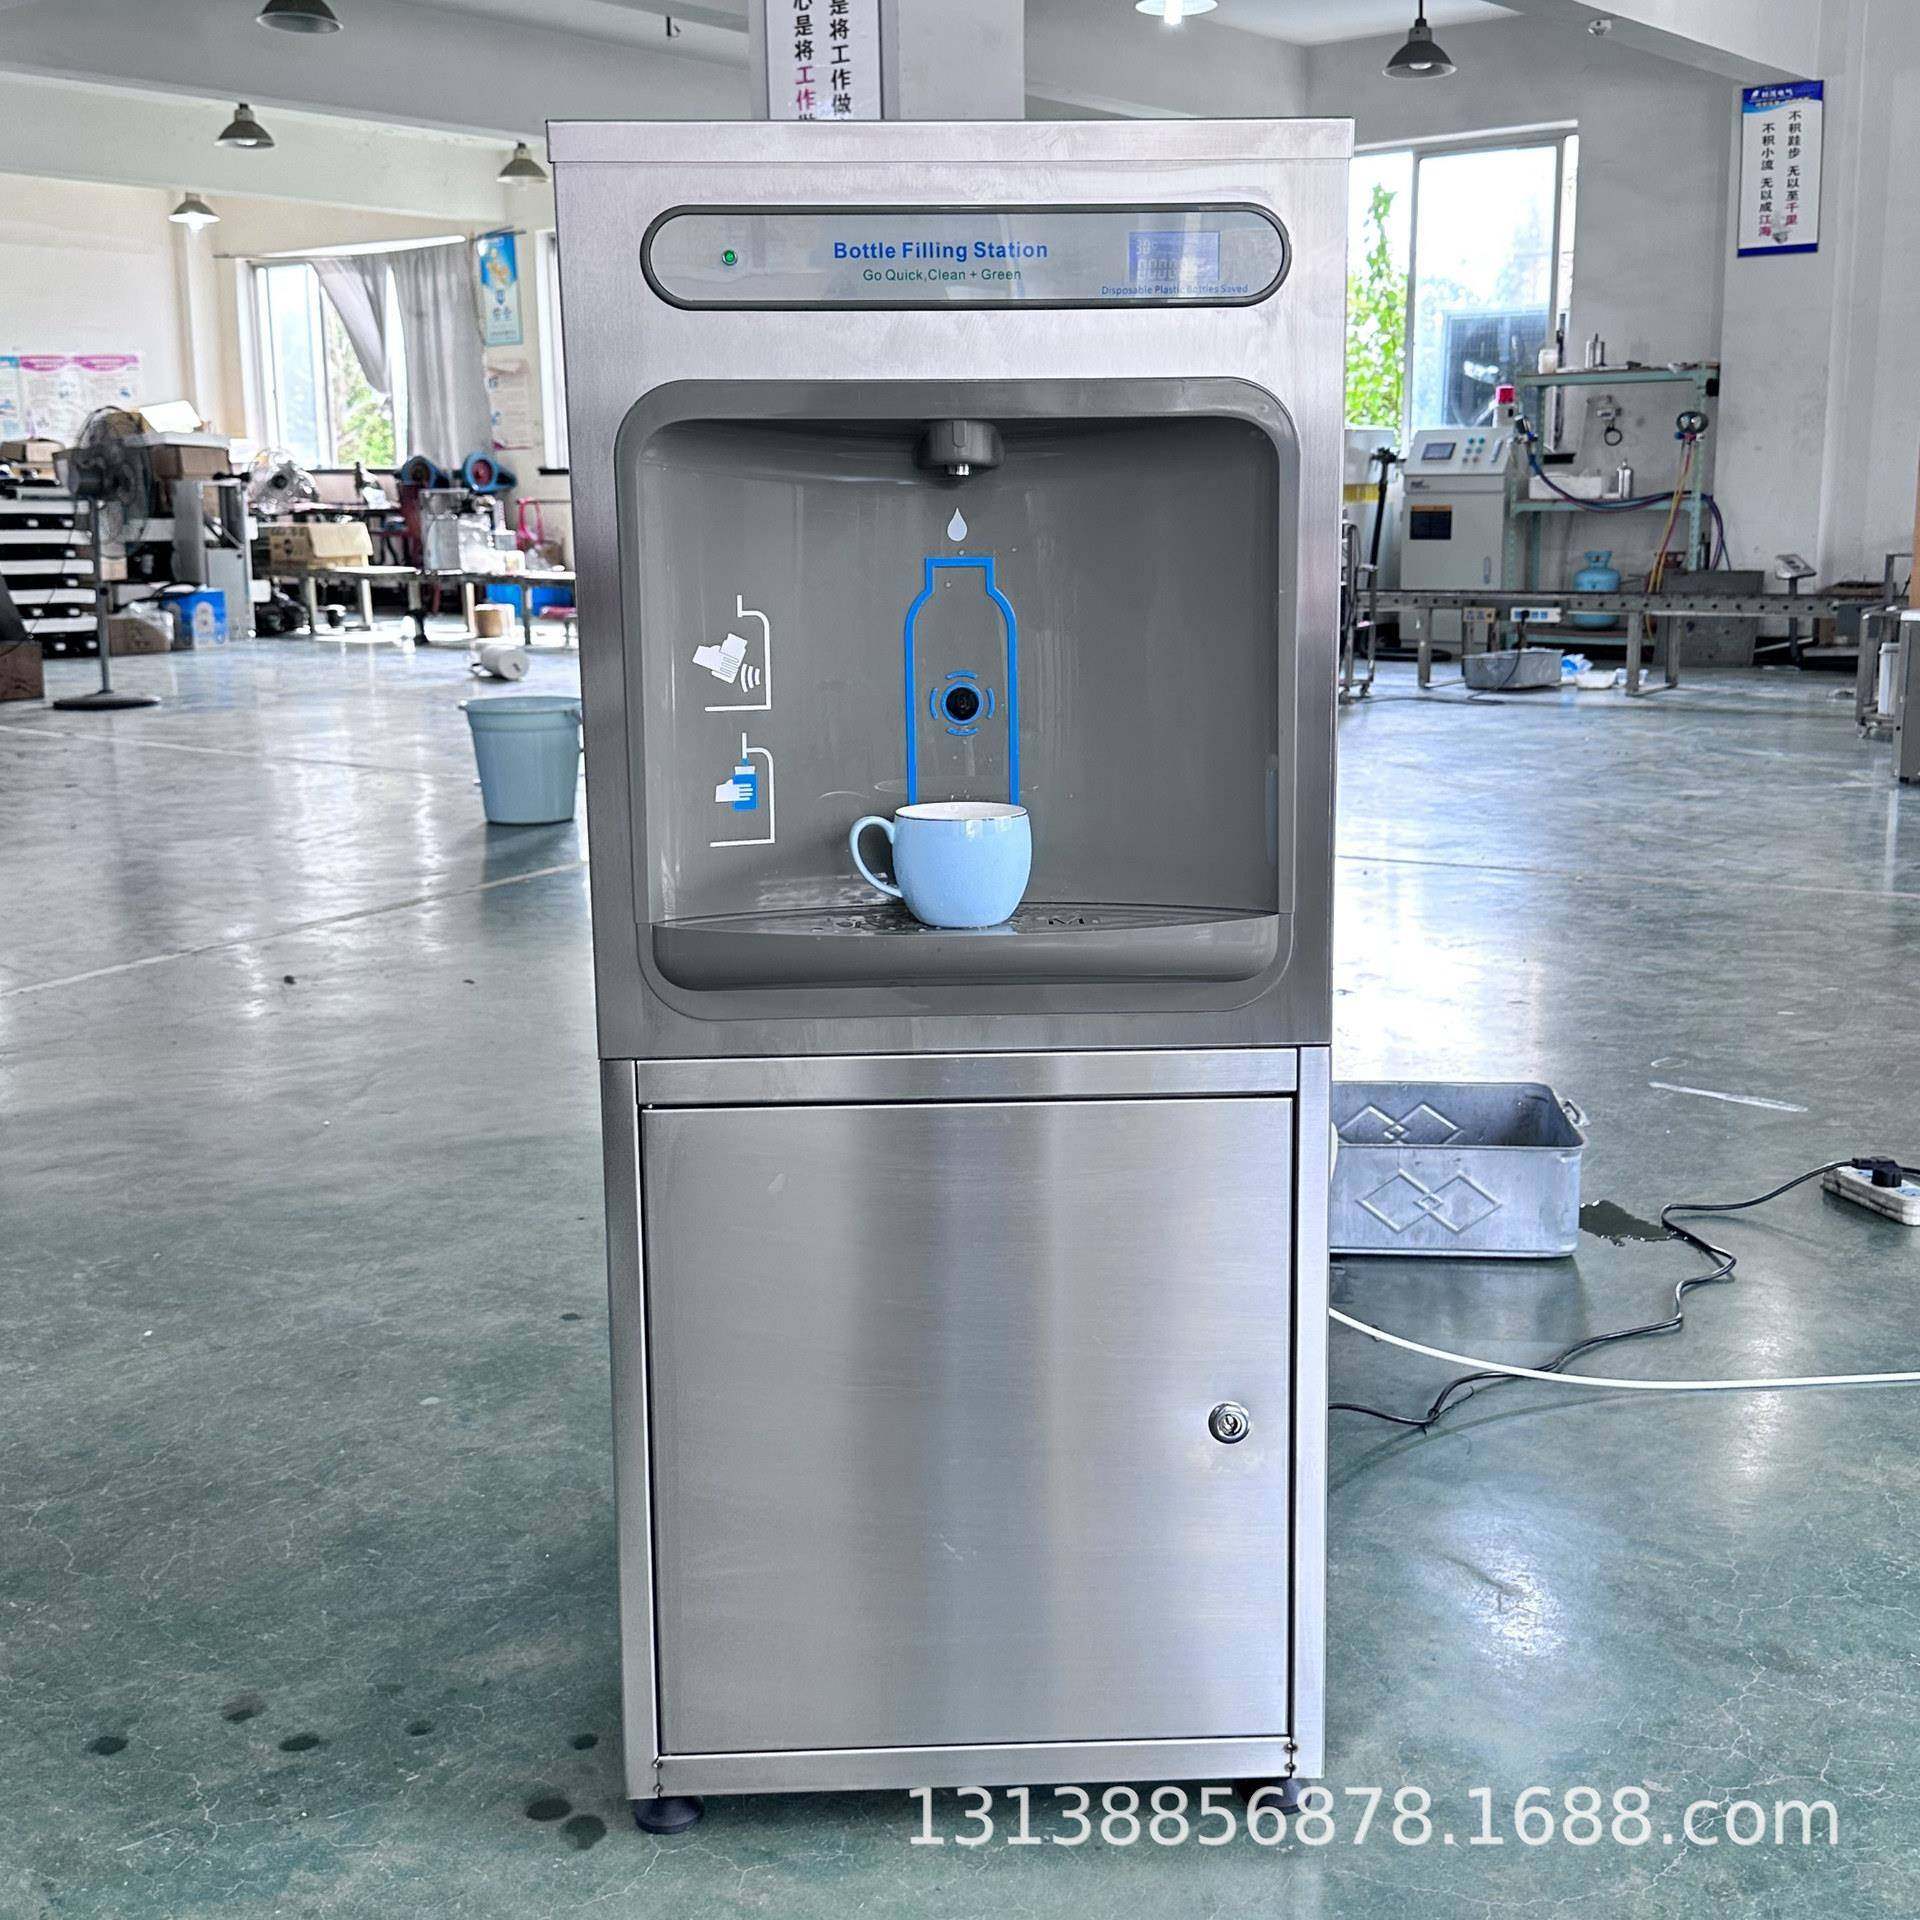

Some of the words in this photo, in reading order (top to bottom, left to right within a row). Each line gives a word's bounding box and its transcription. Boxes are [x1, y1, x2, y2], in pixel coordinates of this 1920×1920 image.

[1761, 122, 1775, 171] 不积小流
[833, 241, 896, 259] Bottle
[902, 241, 968, 262] Filling
[974, 241, 1048, 258] Station
[863, 269, 882, 281] Go
[969, 271, 978, 280] +
[981, 268, 1022, 280] Green
[1101, 285, 1152, 297] Disposable
[1220, 283, 1249, 294] Saved
